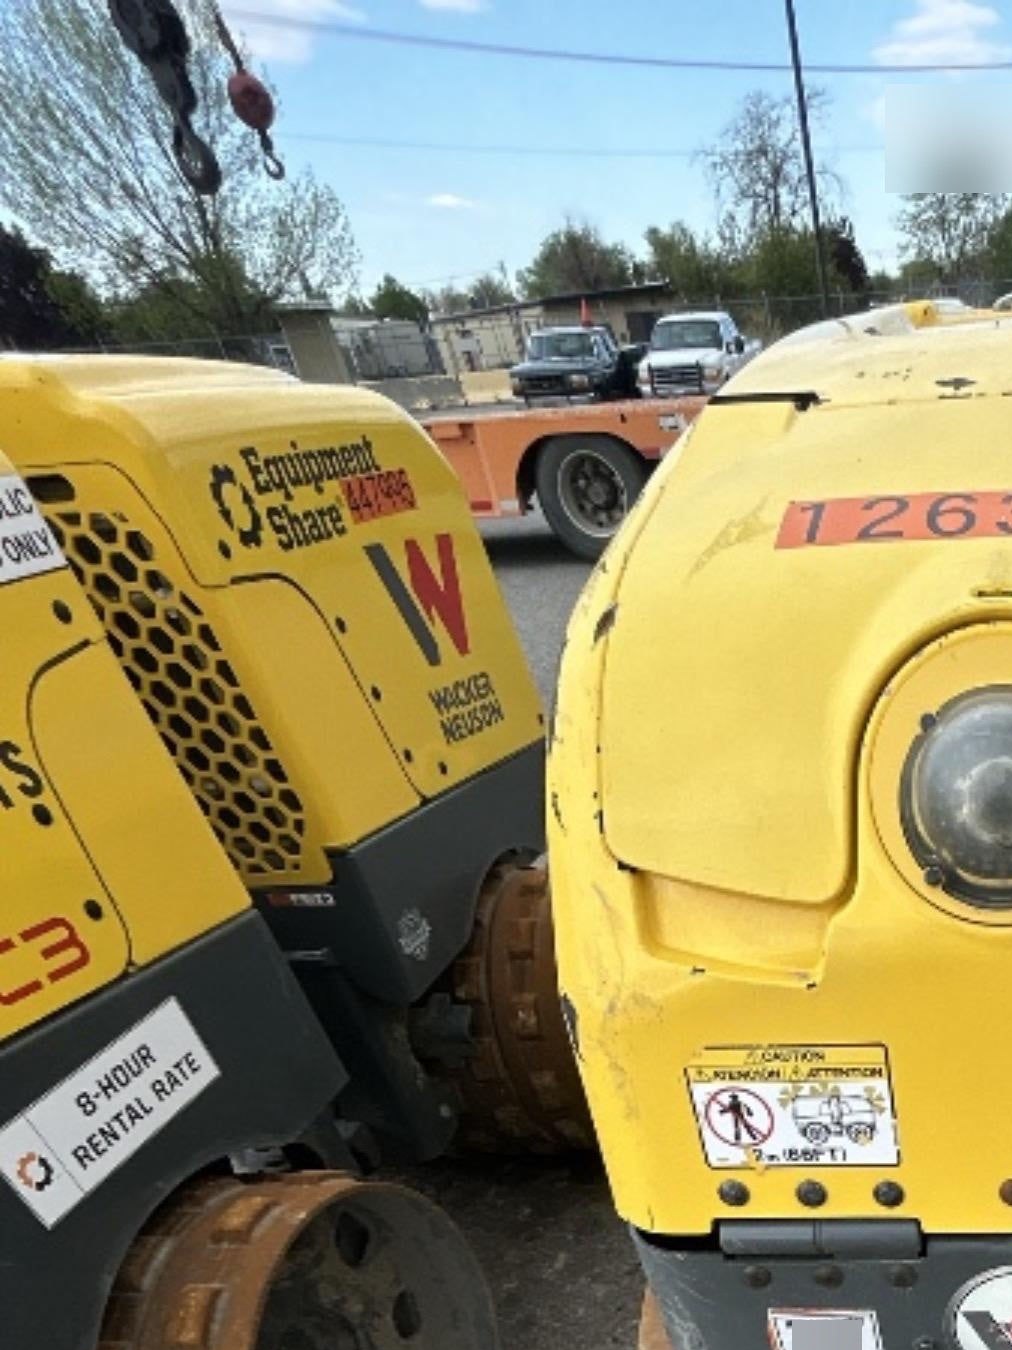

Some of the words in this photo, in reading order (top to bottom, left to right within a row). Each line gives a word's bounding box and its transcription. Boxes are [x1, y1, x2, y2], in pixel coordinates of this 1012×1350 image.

[239, 434, 381, 500] Equipment
[2, 527, 54, 564] ONLY
[266, 504, 347, 551] Share
[428, 671, 496, 716] WACKER
[439, 698, 505, 745] NEUSON
[75, 1044, 157, 1116] 8-HOUR
[762, 1049, 826, 1064] CAUTION
[806, 1066, 883, 1079] ATTENTION
[71, 1097, 154, 1171] RENTAL
[151, 1051, 202, 1102] RATE
